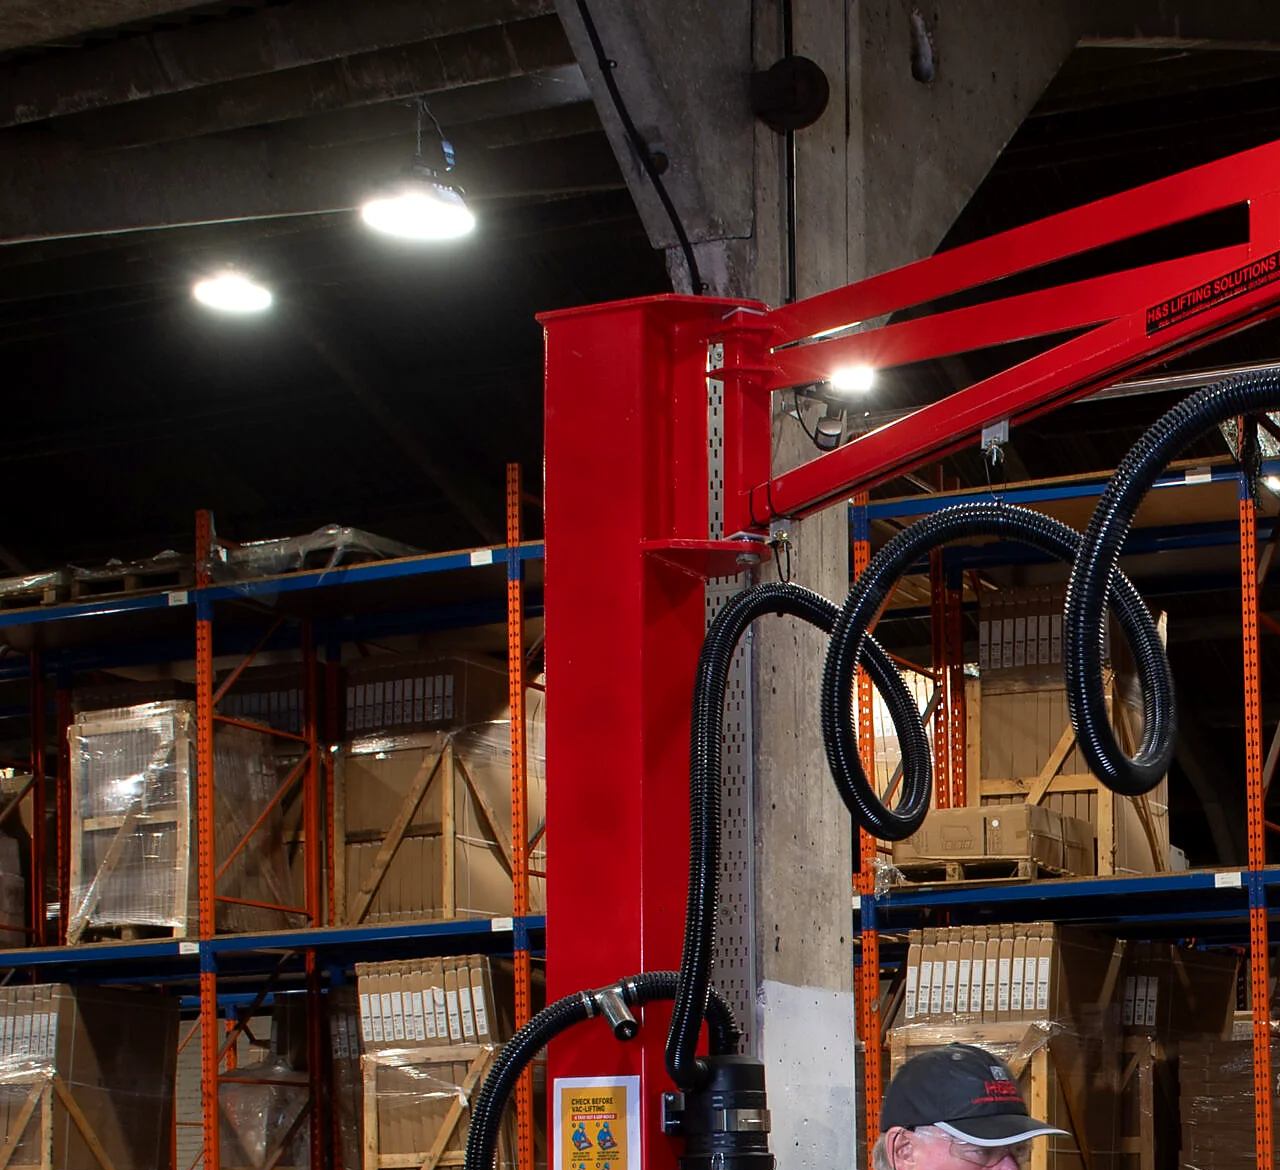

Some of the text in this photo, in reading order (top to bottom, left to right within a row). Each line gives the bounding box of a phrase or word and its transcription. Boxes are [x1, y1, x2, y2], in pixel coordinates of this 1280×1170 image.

[1147, 302, 1169, 324] H&S
[1170, 283, 1212, 314] LIFTING
[1213, 255, 1277, 295] SOLUTIONS
[592, 1097, 613, 1105] BEFORE
